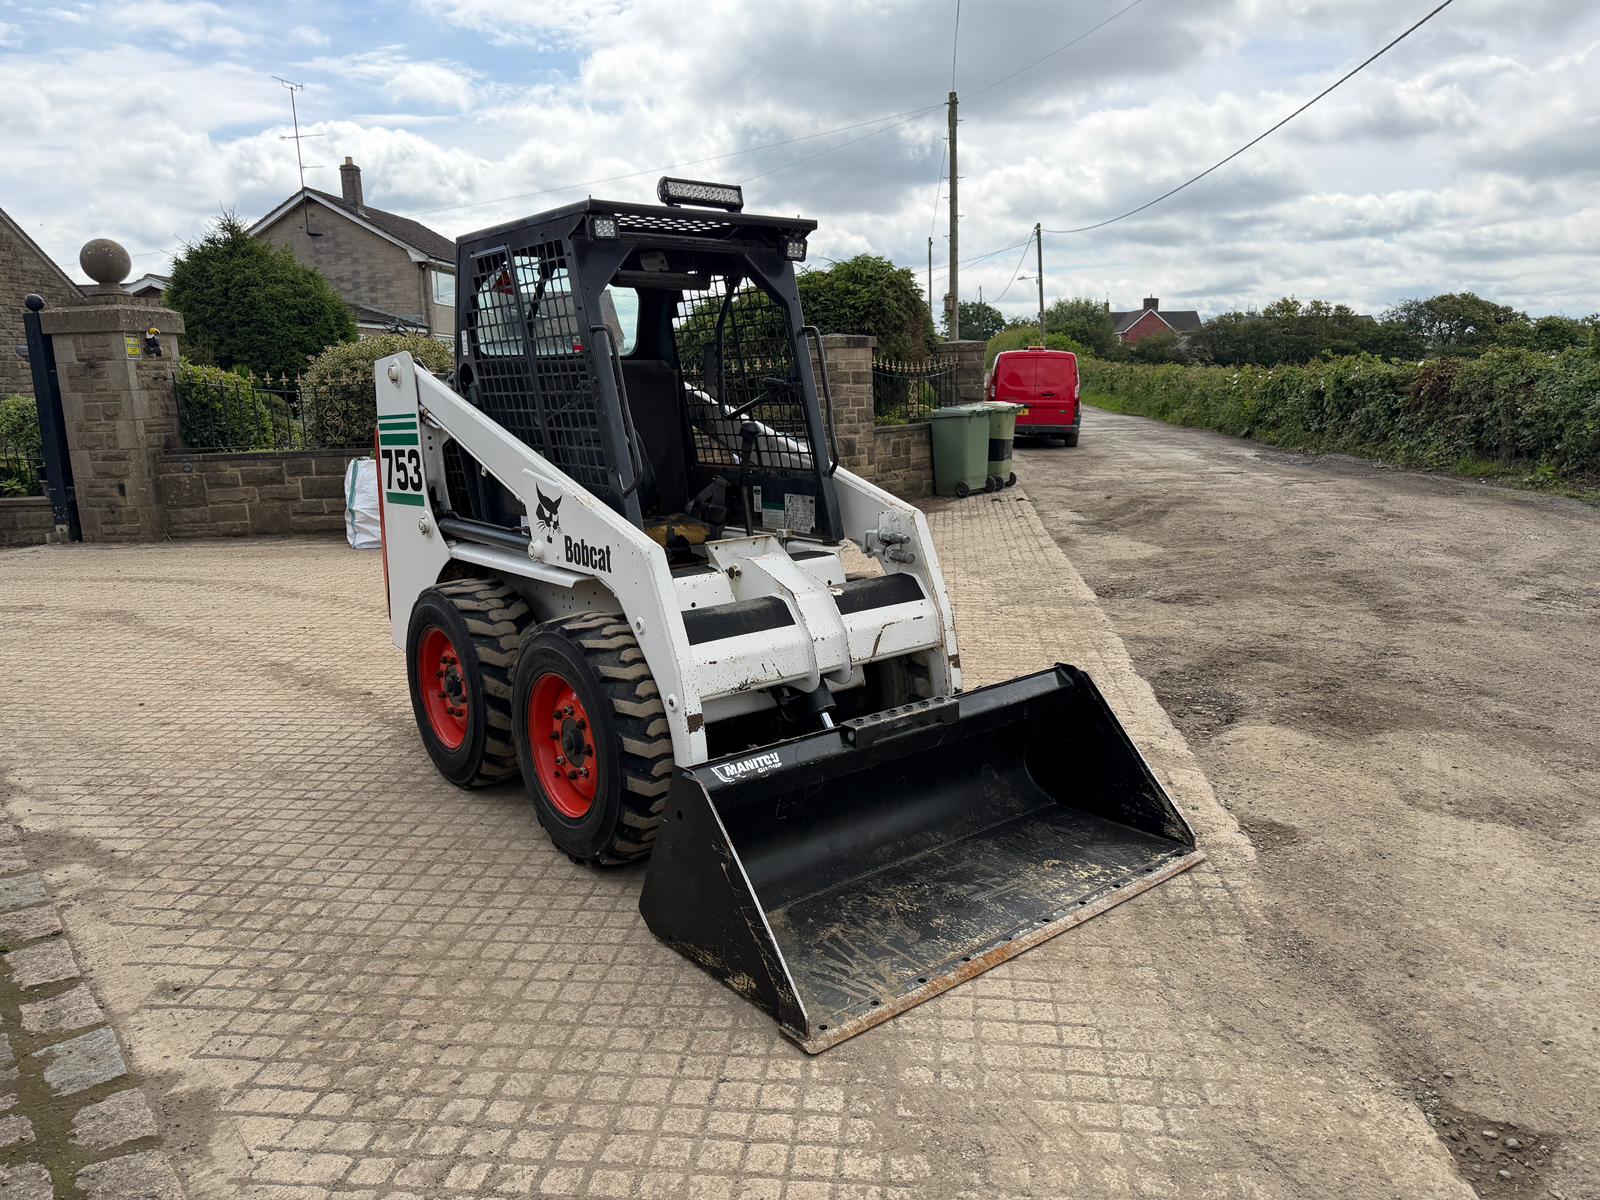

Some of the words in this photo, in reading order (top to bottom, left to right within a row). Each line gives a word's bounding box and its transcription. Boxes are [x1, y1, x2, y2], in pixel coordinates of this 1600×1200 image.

[381, 449, 423, 492] 753
[564, 535, 612, 573] Bobcat
[724, 752, 780, 776] MANITOU
